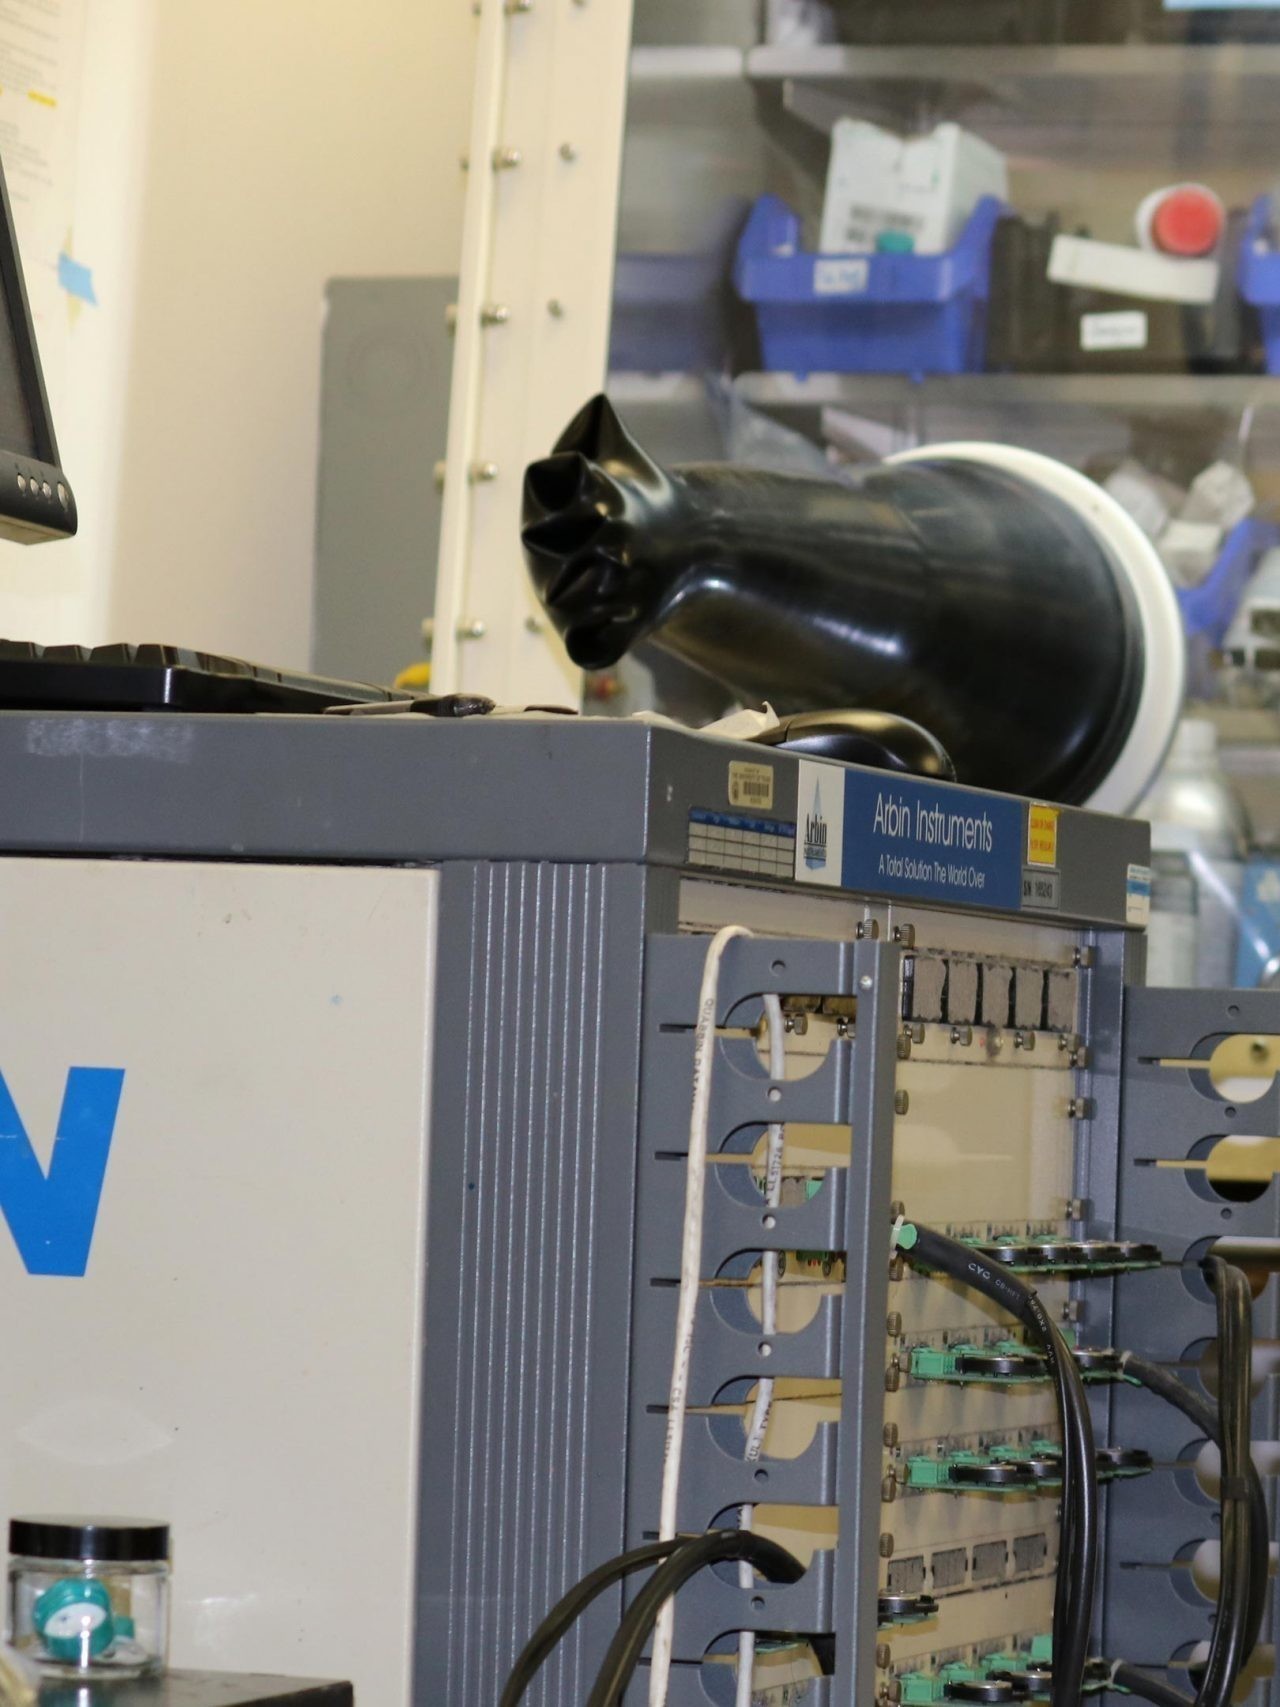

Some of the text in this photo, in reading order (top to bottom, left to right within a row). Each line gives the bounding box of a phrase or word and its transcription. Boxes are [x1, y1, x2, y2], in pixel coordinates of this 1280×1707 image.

[804, 813, 827, 844] Arbin
[873, 792, 993, 852] Arbin Instruments
[878, 853, 985, 888] A Total Solution The World Over
